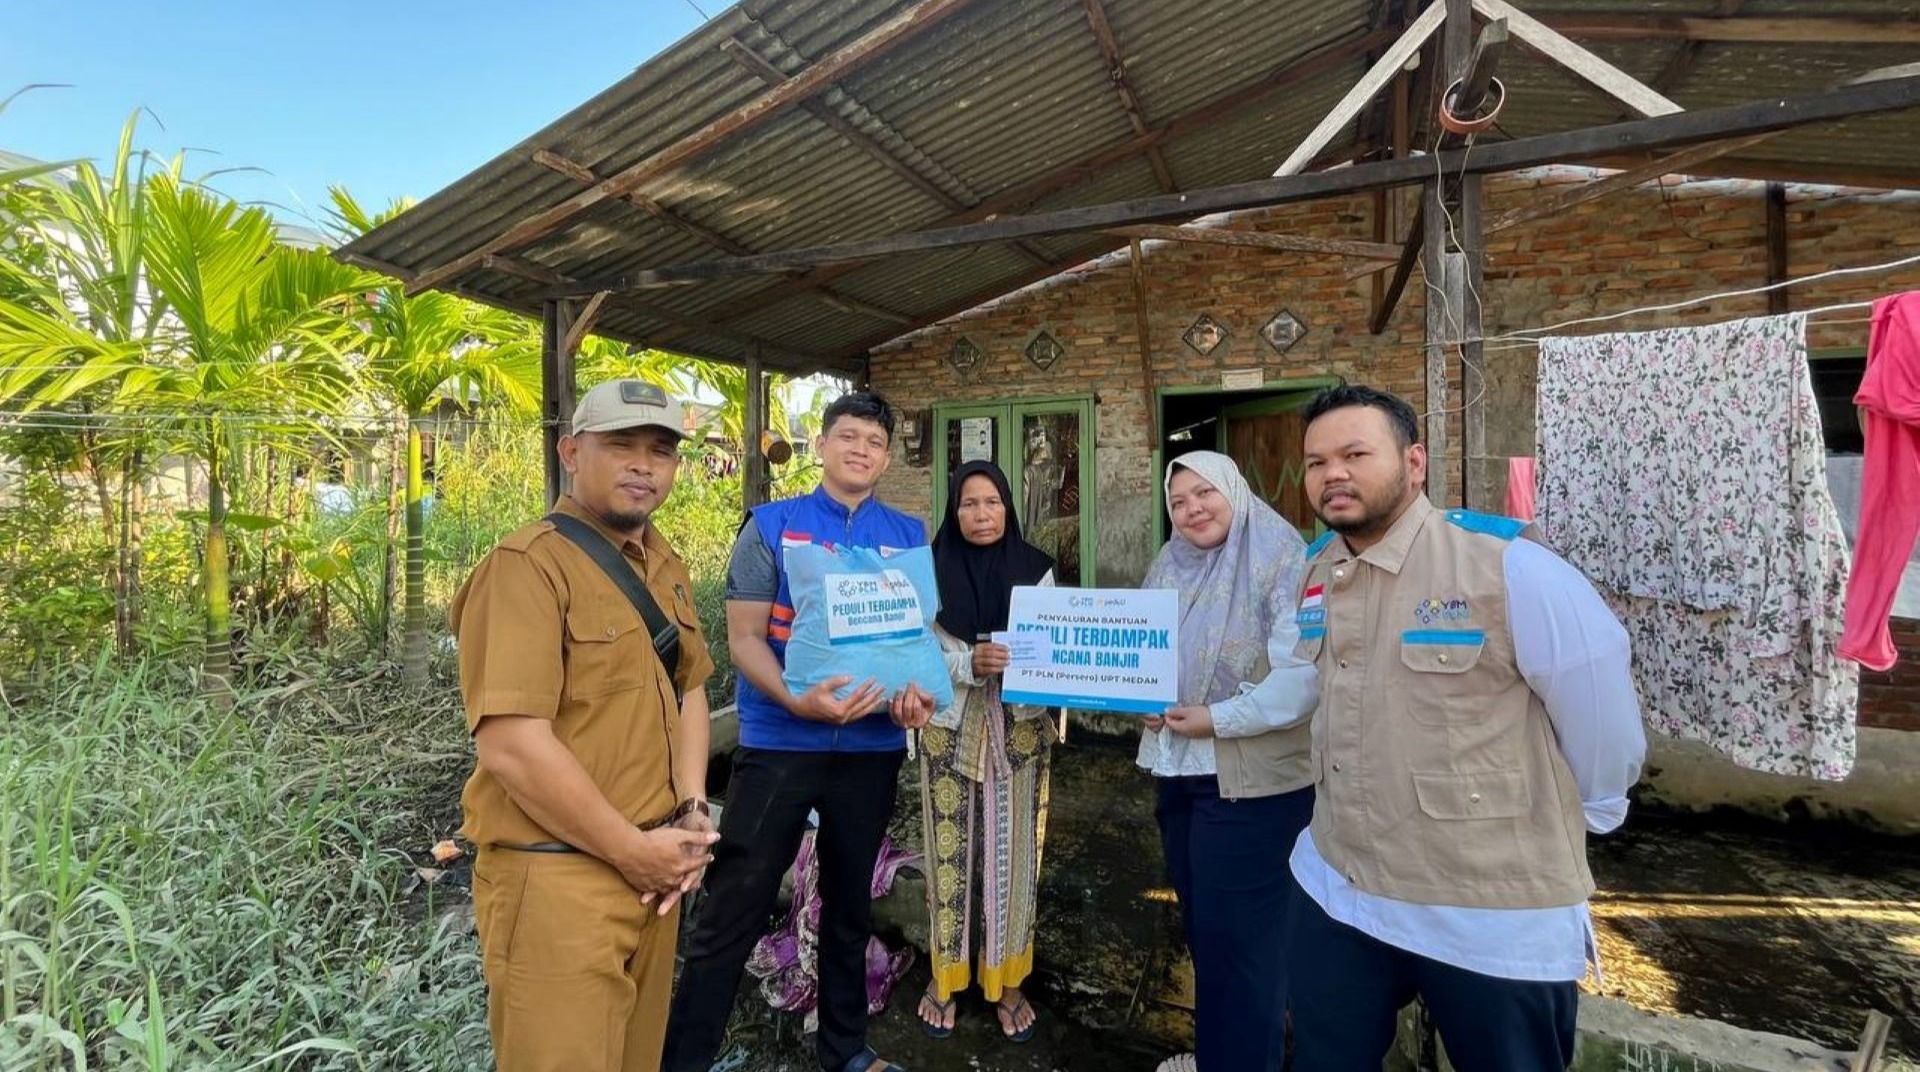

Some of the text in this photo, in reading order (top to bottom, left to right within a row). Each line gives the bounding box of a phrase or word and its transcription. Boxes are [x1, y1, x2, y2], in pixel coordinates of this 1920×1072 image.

[833, 598, 917, 616] PEDULI TERDAMPAK
[1440, 600, 1467, 610] YBM
[1037, 613, 1148, 626] PENYALURAN BANTUAN
[1073, 627, 1169, 649] TERDAMPAK
[1052, 650, 1091, 666] NCANA
[1095, 652, 1140, 668] BANJIR
[1021, 669, 1159, 685] PT PLN (Persero) UPT MEDAN
